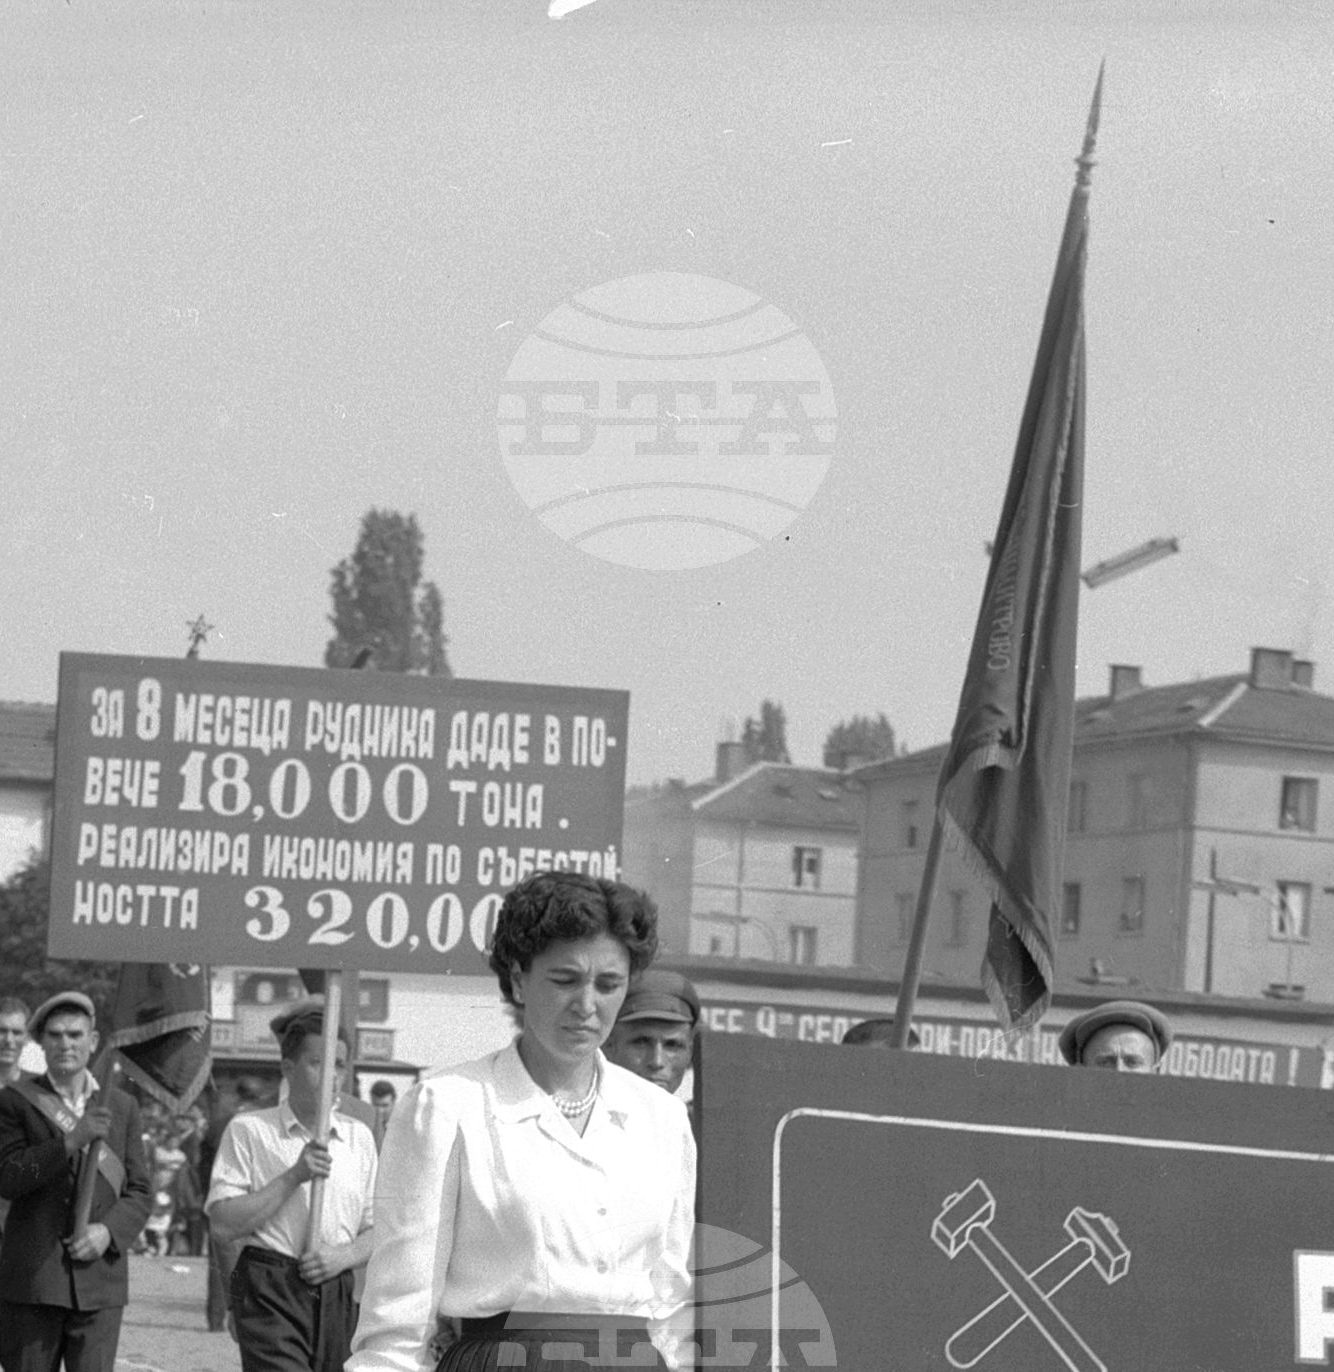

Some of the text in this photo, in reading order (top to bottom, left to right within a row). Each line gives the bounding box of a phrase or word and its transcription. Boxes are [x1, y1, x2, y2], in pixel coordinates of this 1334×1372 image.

[91, 678, 617, 772] ЗА 8 МЕСЕЦА РУДНИКА ДАДЕ В ПО-
[83, 757, 161, 808] ВЕЧЕ
[77, 823, 250, 876] РЕАЛИЗИРА
[263, 834, 414, 885] ИКОНОМИЯ
[425, 843, 461, 885] ПО
[72, 880, 199, 930] НОСТТА
